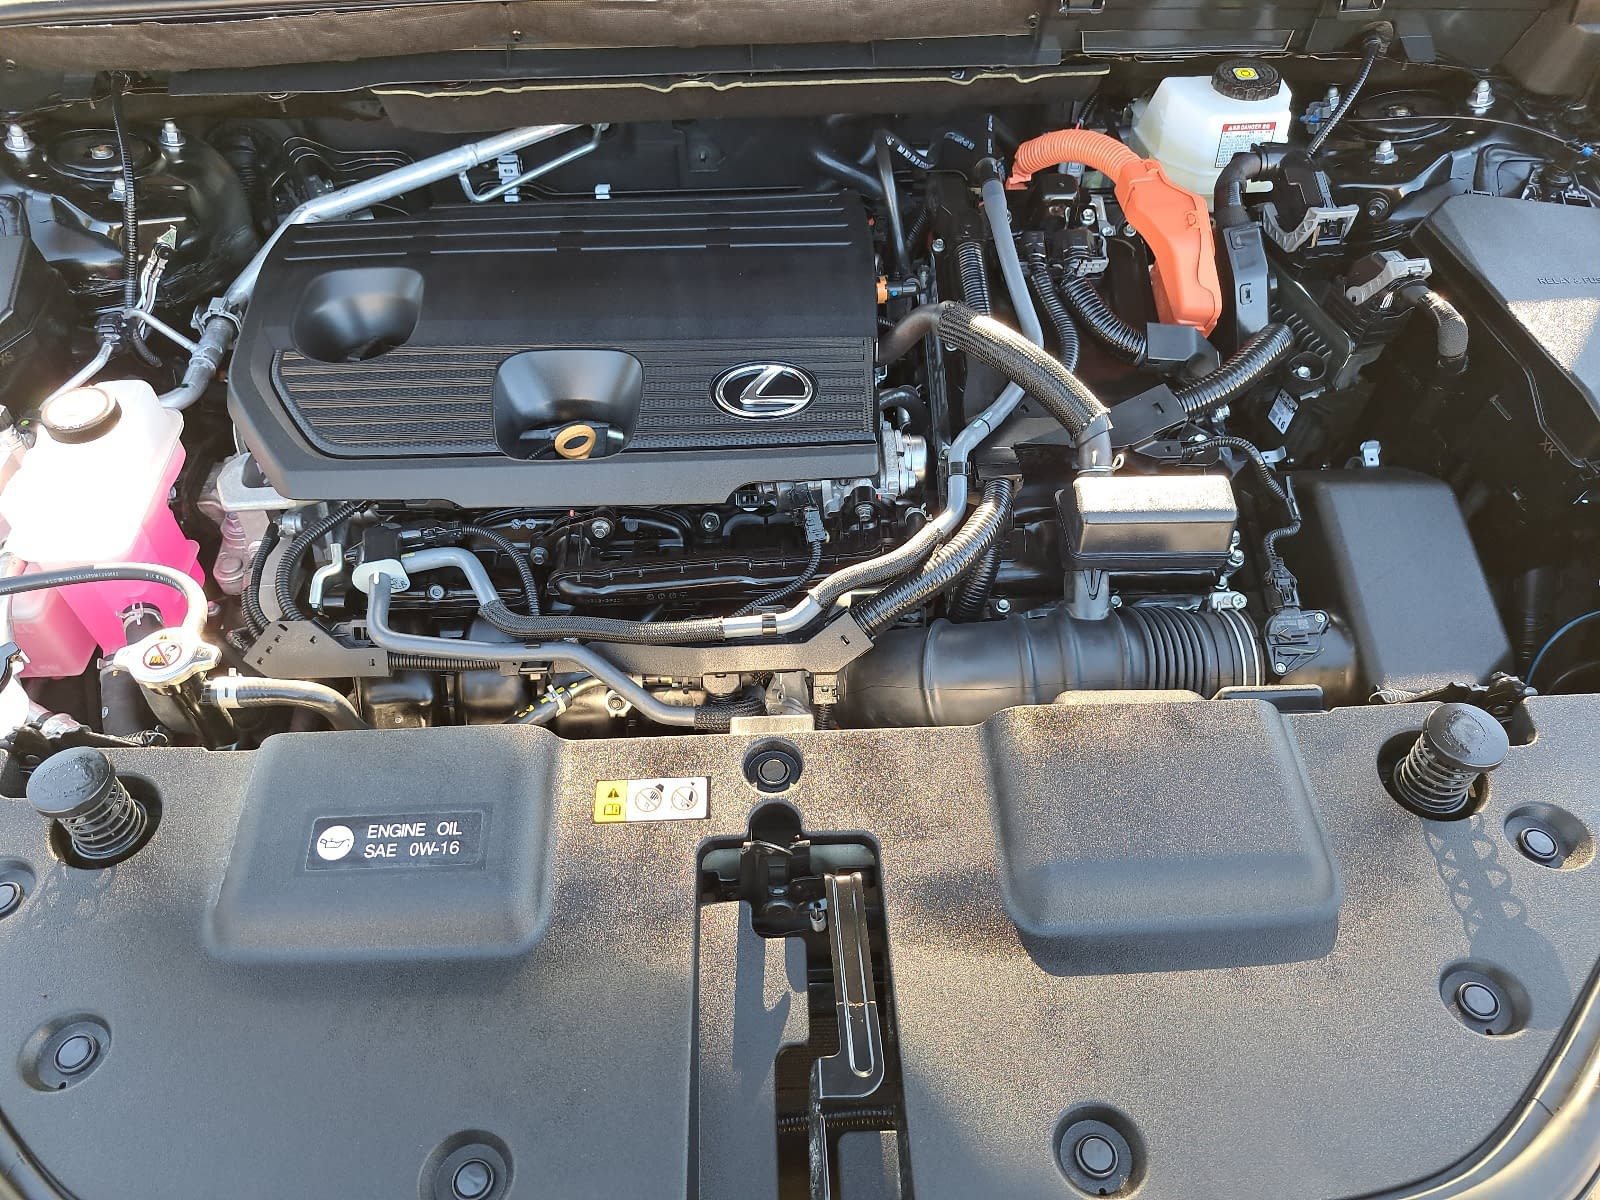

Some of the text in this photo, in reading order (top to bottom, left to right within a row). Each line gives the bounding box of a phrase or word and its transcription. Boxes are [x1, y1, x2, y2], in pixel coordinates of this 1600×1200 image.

[367, 821, 463, 839] ENGINE OIL
[363, 840, 460, 859] SAE 0W-16
